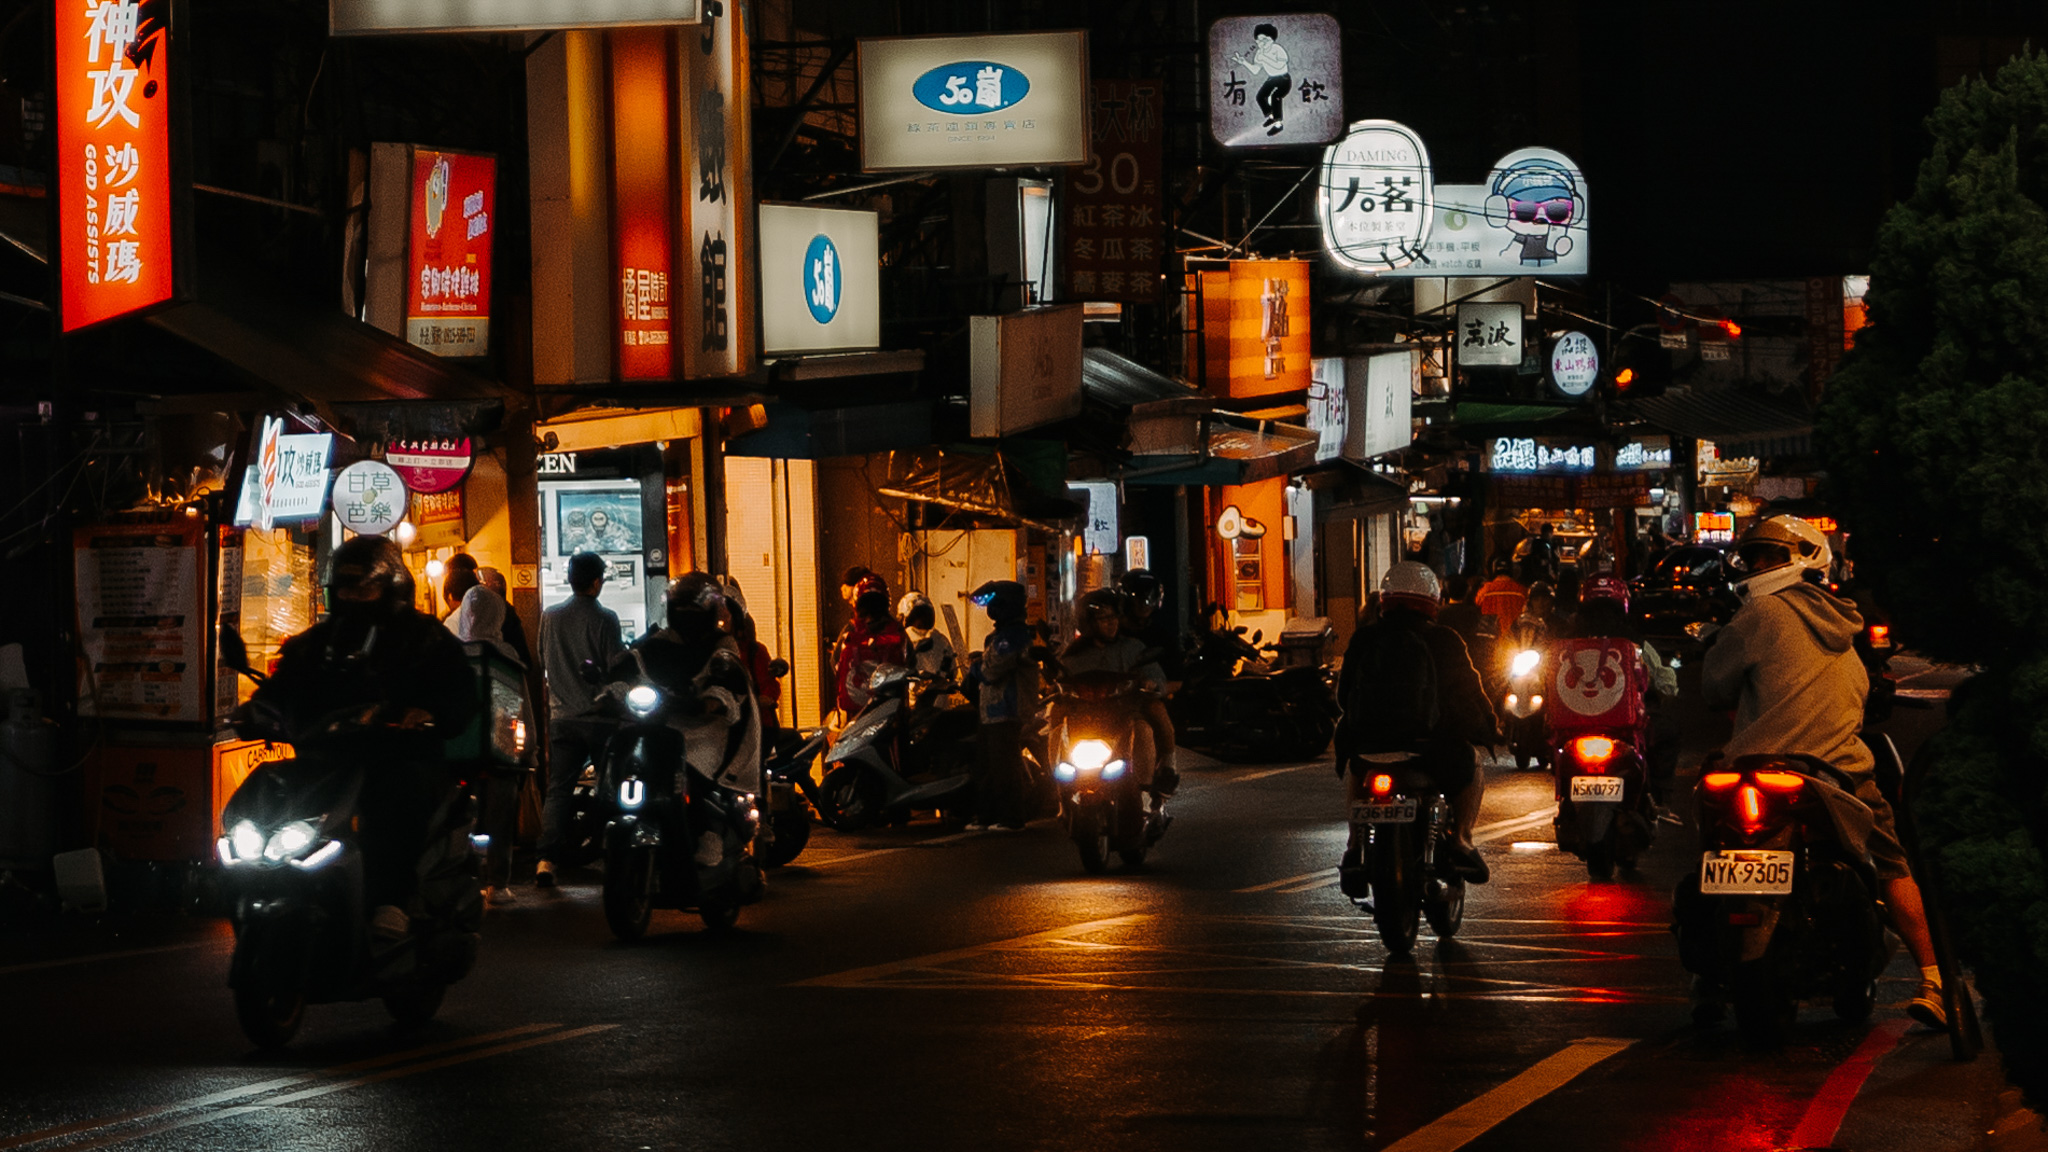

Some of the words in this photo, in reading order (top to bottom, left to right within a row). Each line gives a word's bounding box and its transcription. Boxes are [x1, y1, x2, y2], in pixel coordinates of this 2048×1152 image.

[84, 0, 140, 130] 神攻
[939, 66, 1003, 108] 50嵐
[1223, 70, 1247, 106] 有
[1298, 77, 1329, 103] 飲
[85, 143, 98, 191] GOD
[1346, 150, 1407, 162] DAMING
[102, 142, 144, 284] 沙威瑪
[1072, 203, 1154, 228] 紅茶冰
[86, 193, 99, 284] ASSISTS
[1073, 237, 1154, 261] 冬瓜茶
[1072, 270, 1154, 295] 蕎麥茶
[347, 471, 392, 494] 甘草
[346, 501, 392, 524] 芭樂
[1703, 863, 1791, 884] NYK-9305
